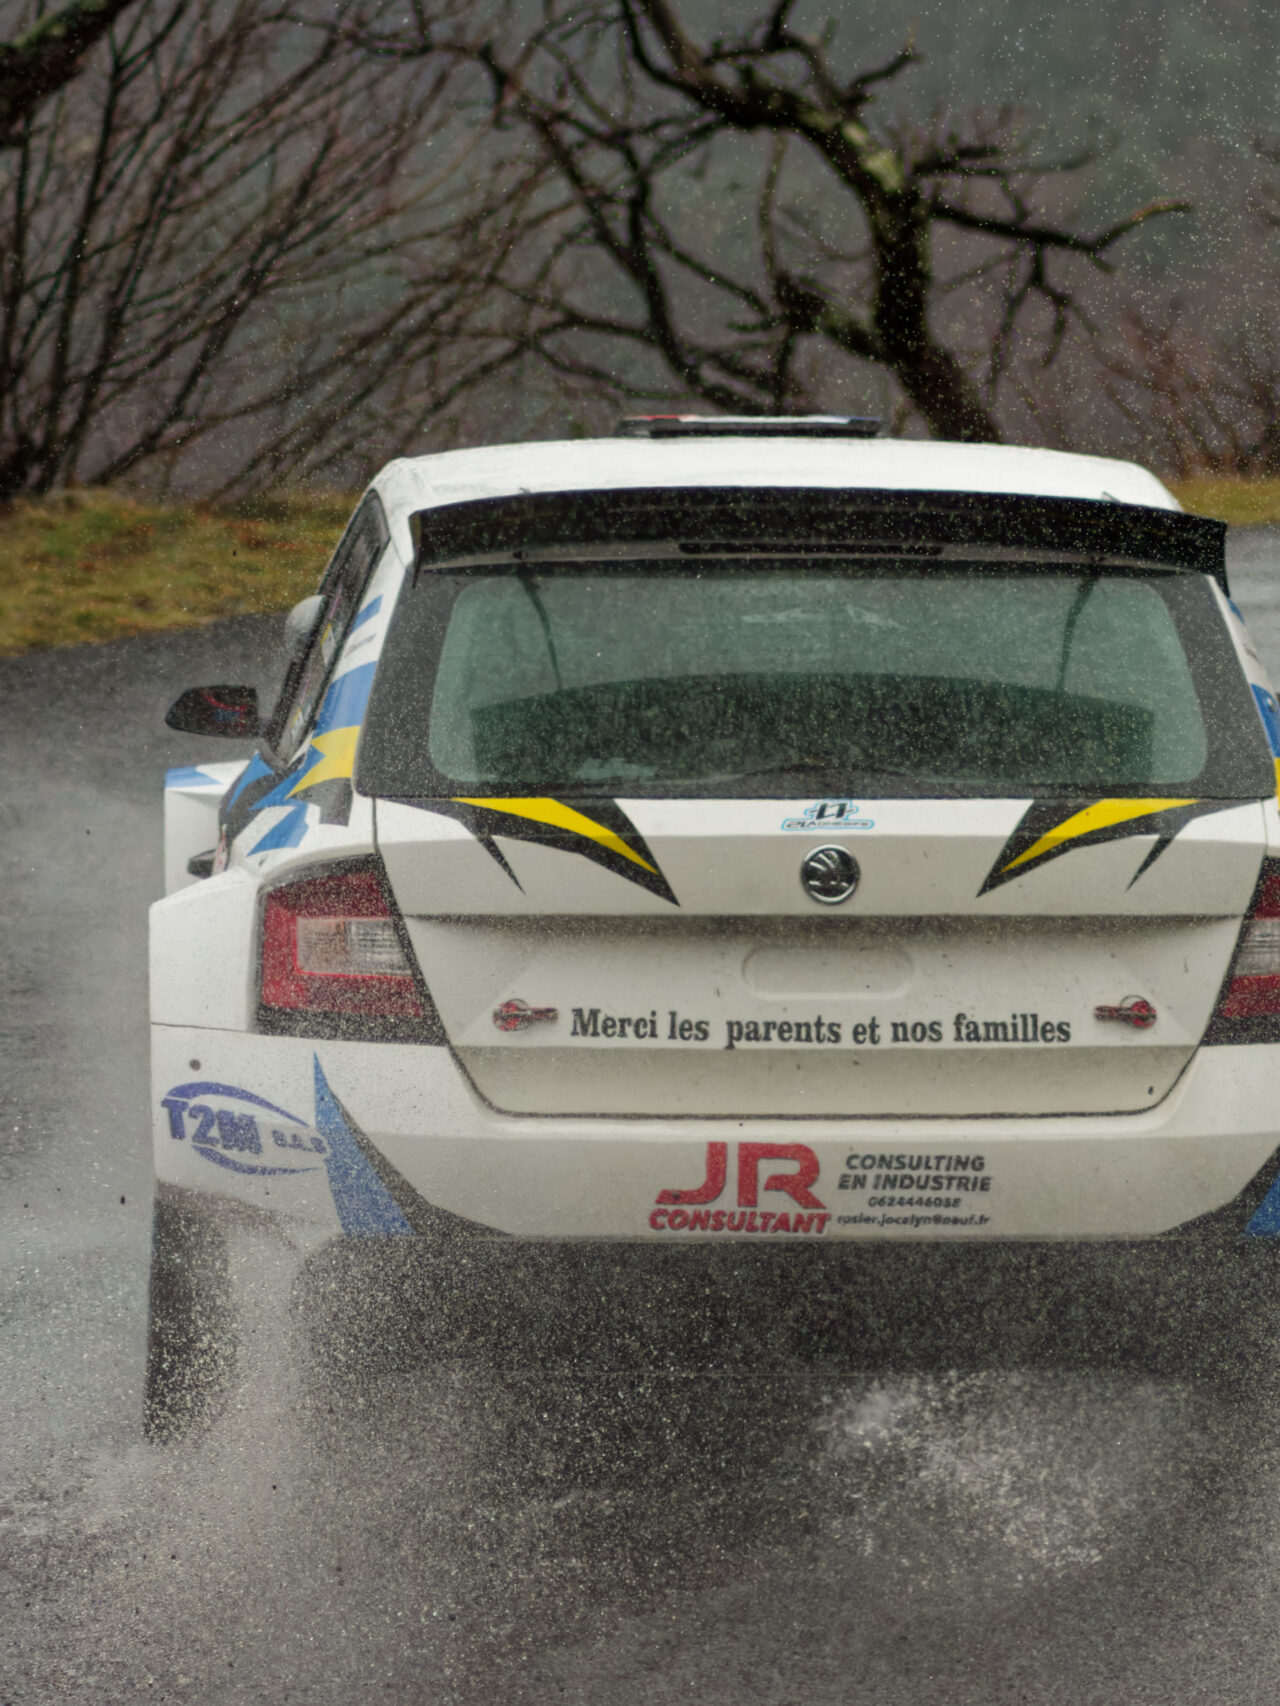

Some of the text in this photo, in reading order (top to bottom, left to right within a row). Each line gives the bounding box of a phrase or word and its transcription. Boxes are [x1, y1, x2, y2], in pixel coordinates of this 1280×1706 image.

[570, 1007, 1071, 1050] Merci les parents et nos familles
[160, 1097, 263, 1155] T2M
[654, 1141, 827, 1209] JR
[846, 1154, 985, 1172] CONSULTING
[838, 1173, 992, 1192] EN INDUSTRIE
[649, 1207, 832, 1234] CONSULTANT
